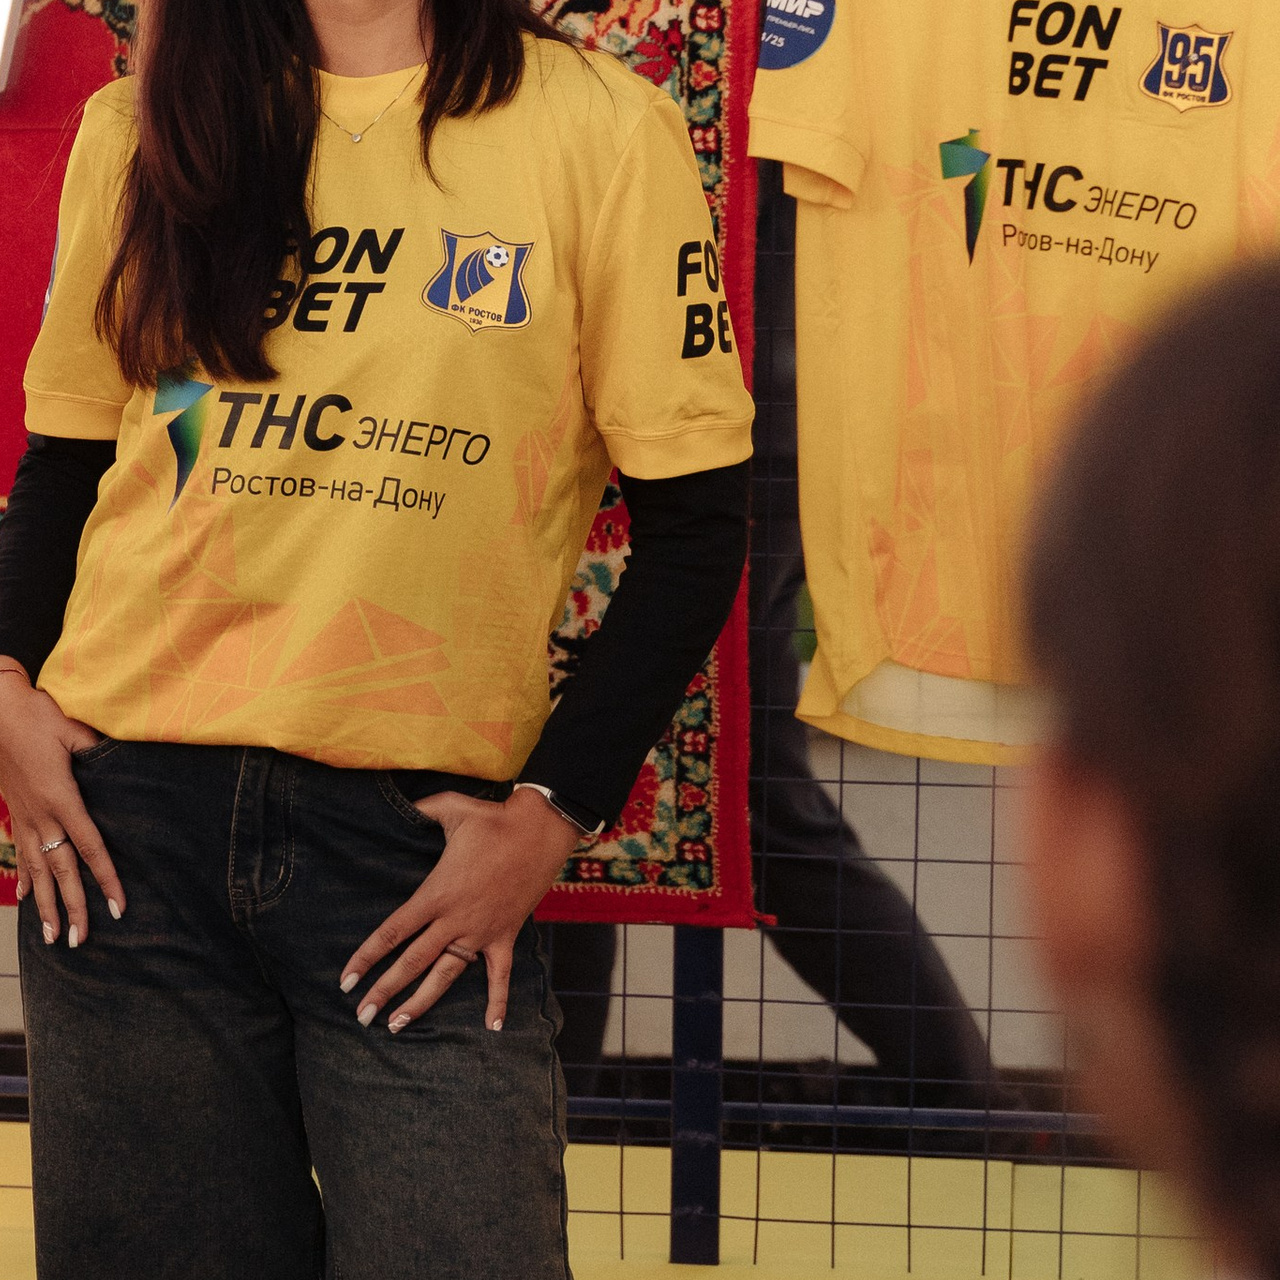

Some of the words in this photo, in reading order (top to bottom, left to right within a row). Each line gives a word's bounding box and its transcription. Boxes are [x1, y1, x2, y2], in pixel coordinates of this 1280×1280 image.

[1008, 0, 1122, 50] FON
[1008, 51, 1109, 101] BET
[1164, 33, 1214, 92] 95
[996, 158, 1084, 212] ТНС
[1084, 186, 1197, 231] ЭНЕРГО
[278, 226, 406, 274] ON
[451, 304, 465, 314] ФК
[468, 306, 503, 322] РОСТОВ
[218, 391, 353, 451] ТНС
[352, 416, 491, 466] ЭНЕРГО
[211, 467, 446, 520] Ростов-на-Дону
